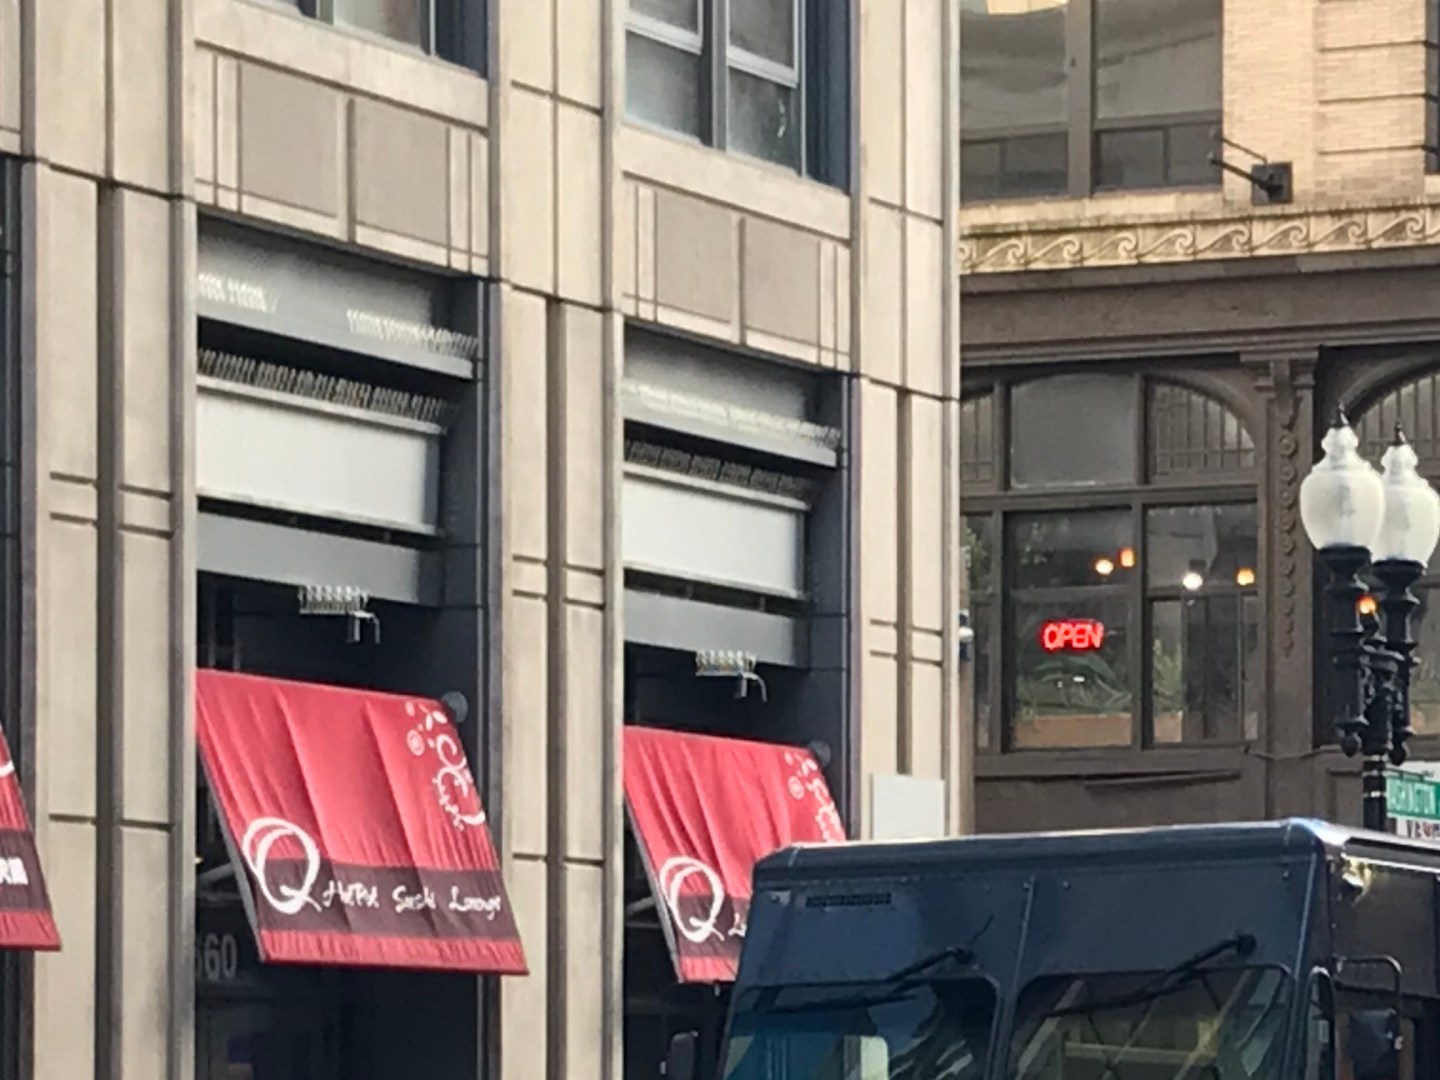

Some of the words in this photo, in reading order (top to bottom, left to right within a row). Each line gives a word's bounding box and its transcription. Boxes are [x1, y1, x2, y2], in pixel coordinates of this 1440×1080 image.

[1043, 622, 1104, 650] OPEN
[243, 817, 323, 914] Q
[660, 857, 725, 942] Q
[203, 933, 238, 981] 60
